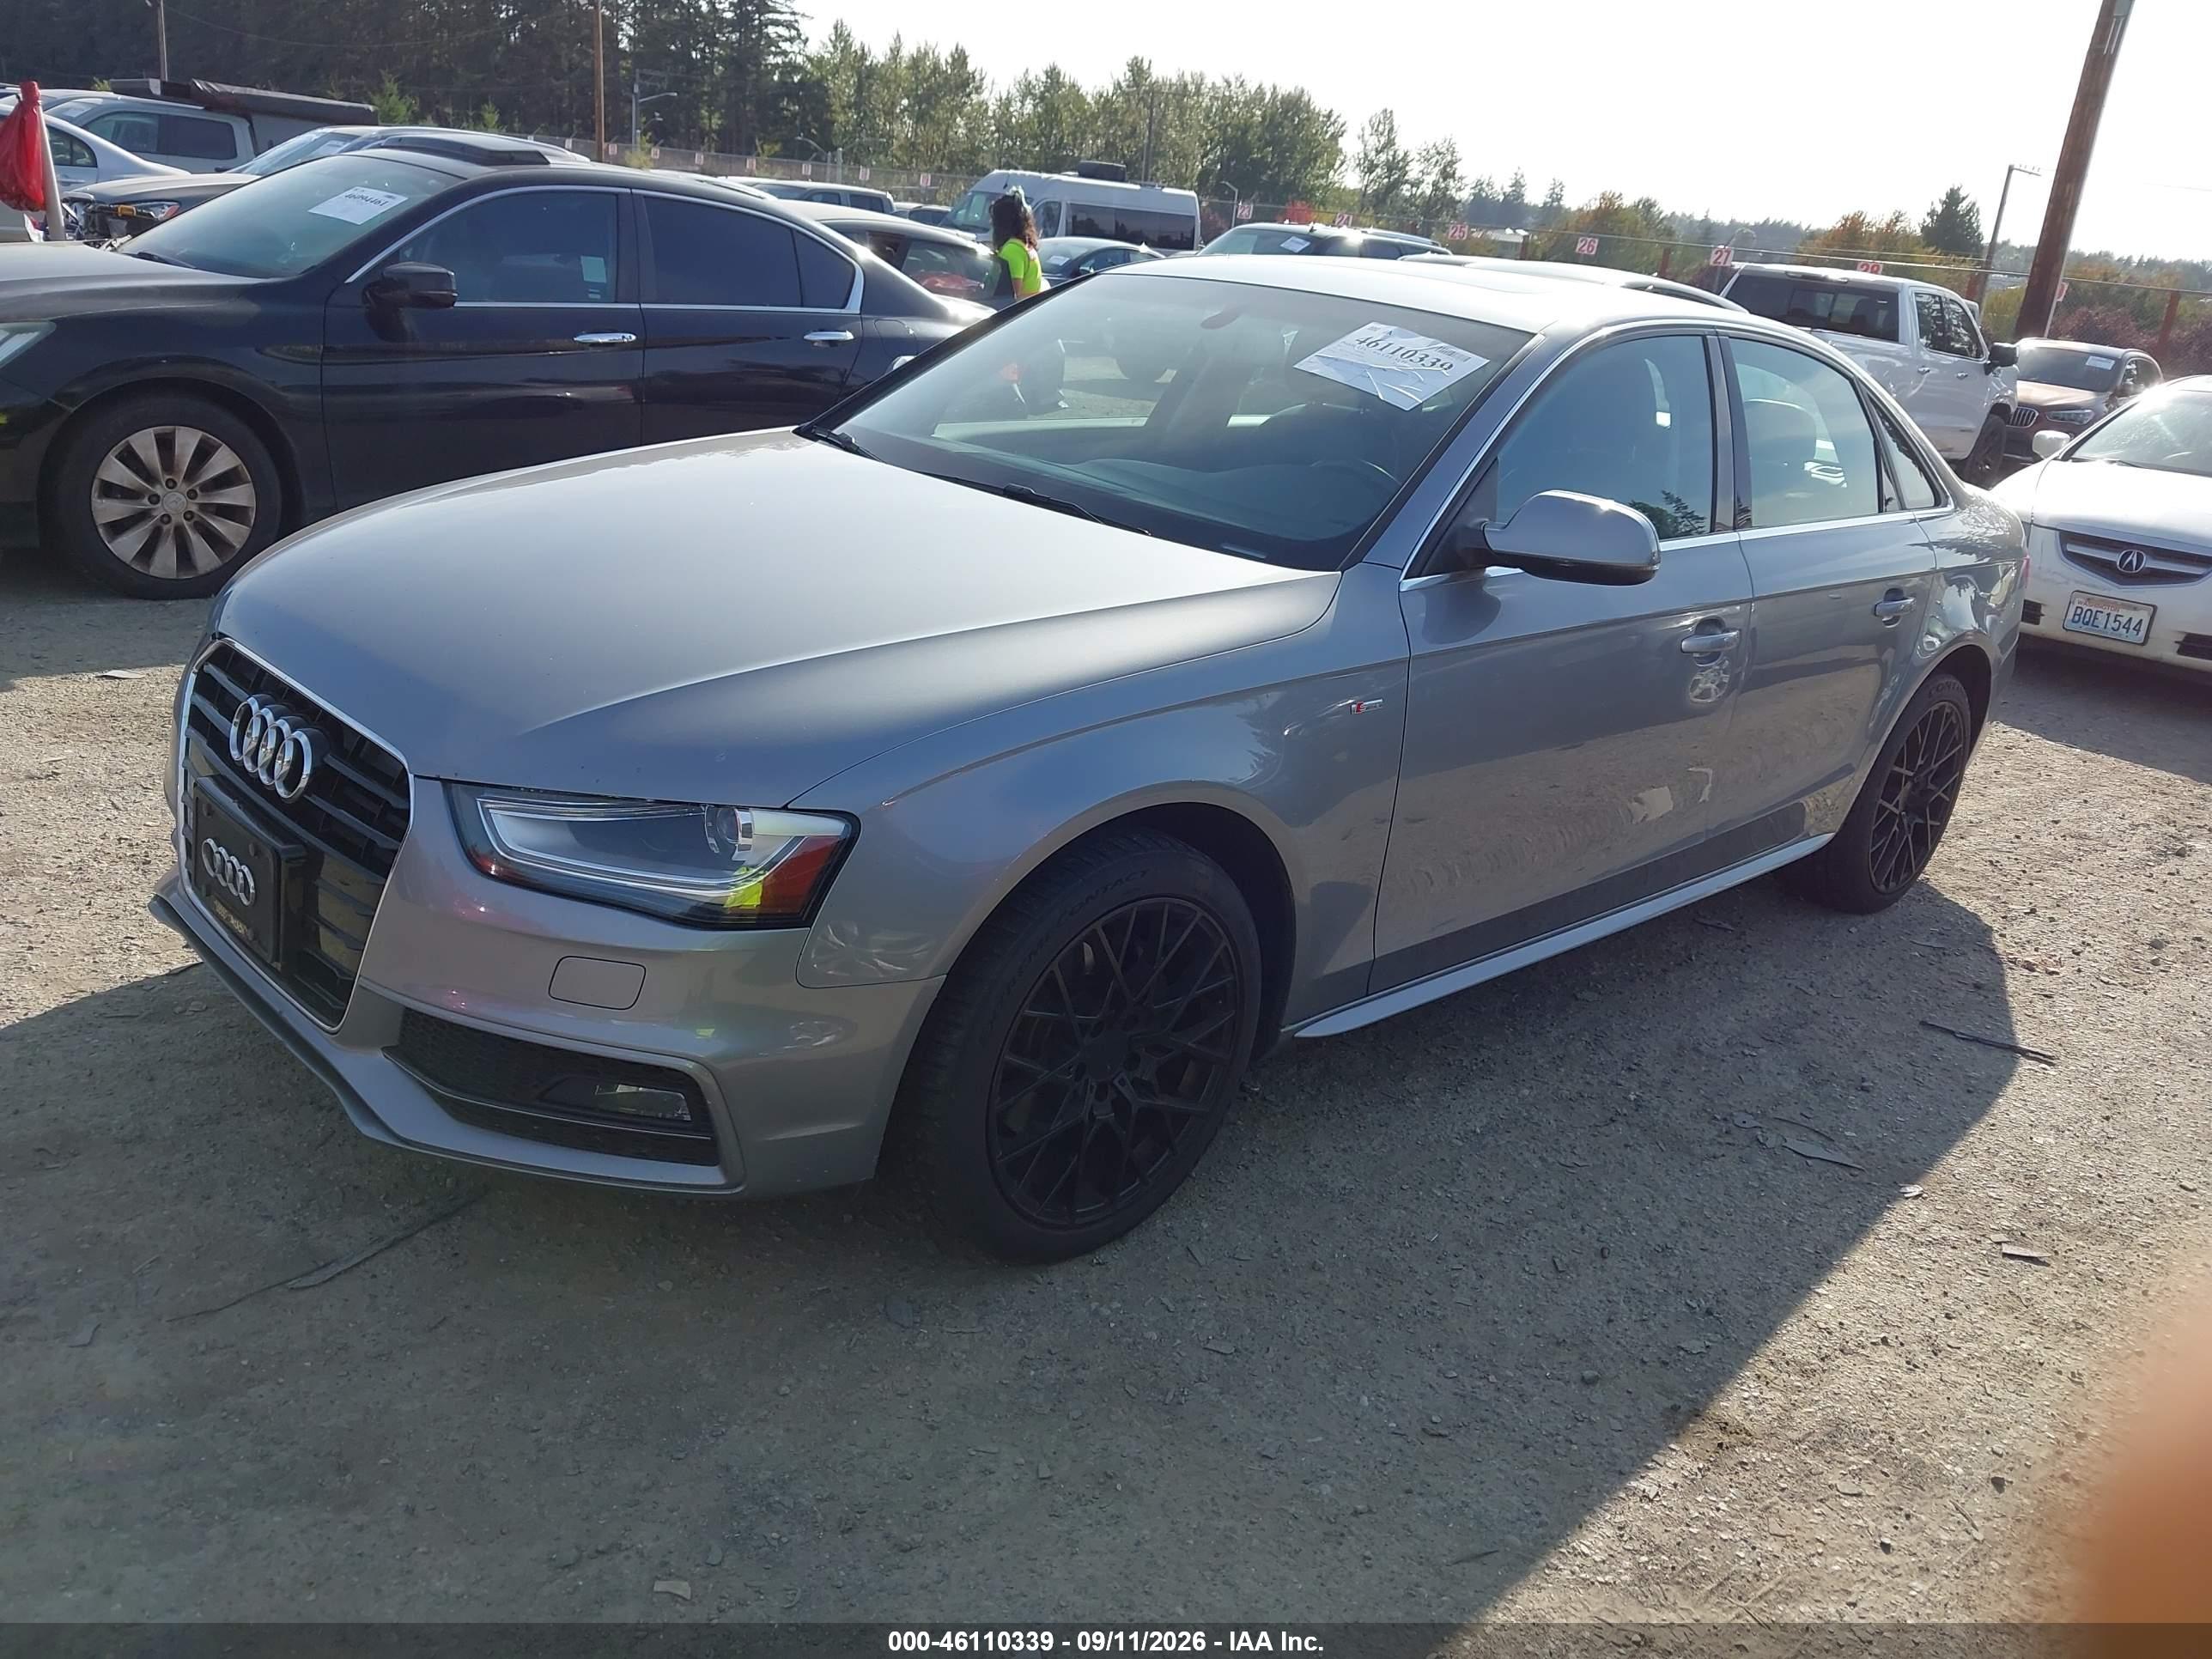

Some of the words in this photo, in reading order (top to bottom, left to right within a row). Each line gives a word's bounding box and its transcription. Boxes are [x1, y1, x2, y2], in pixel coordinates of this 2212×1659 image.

[1450, 225, 1466, 240] 25
[1578, 238, 1596, 253] 26
[1712, 249, 1731, 265] 27
[1356, 336, 1454, 371] 46110339
[2070, 605, 2143, 636] BQE1544
